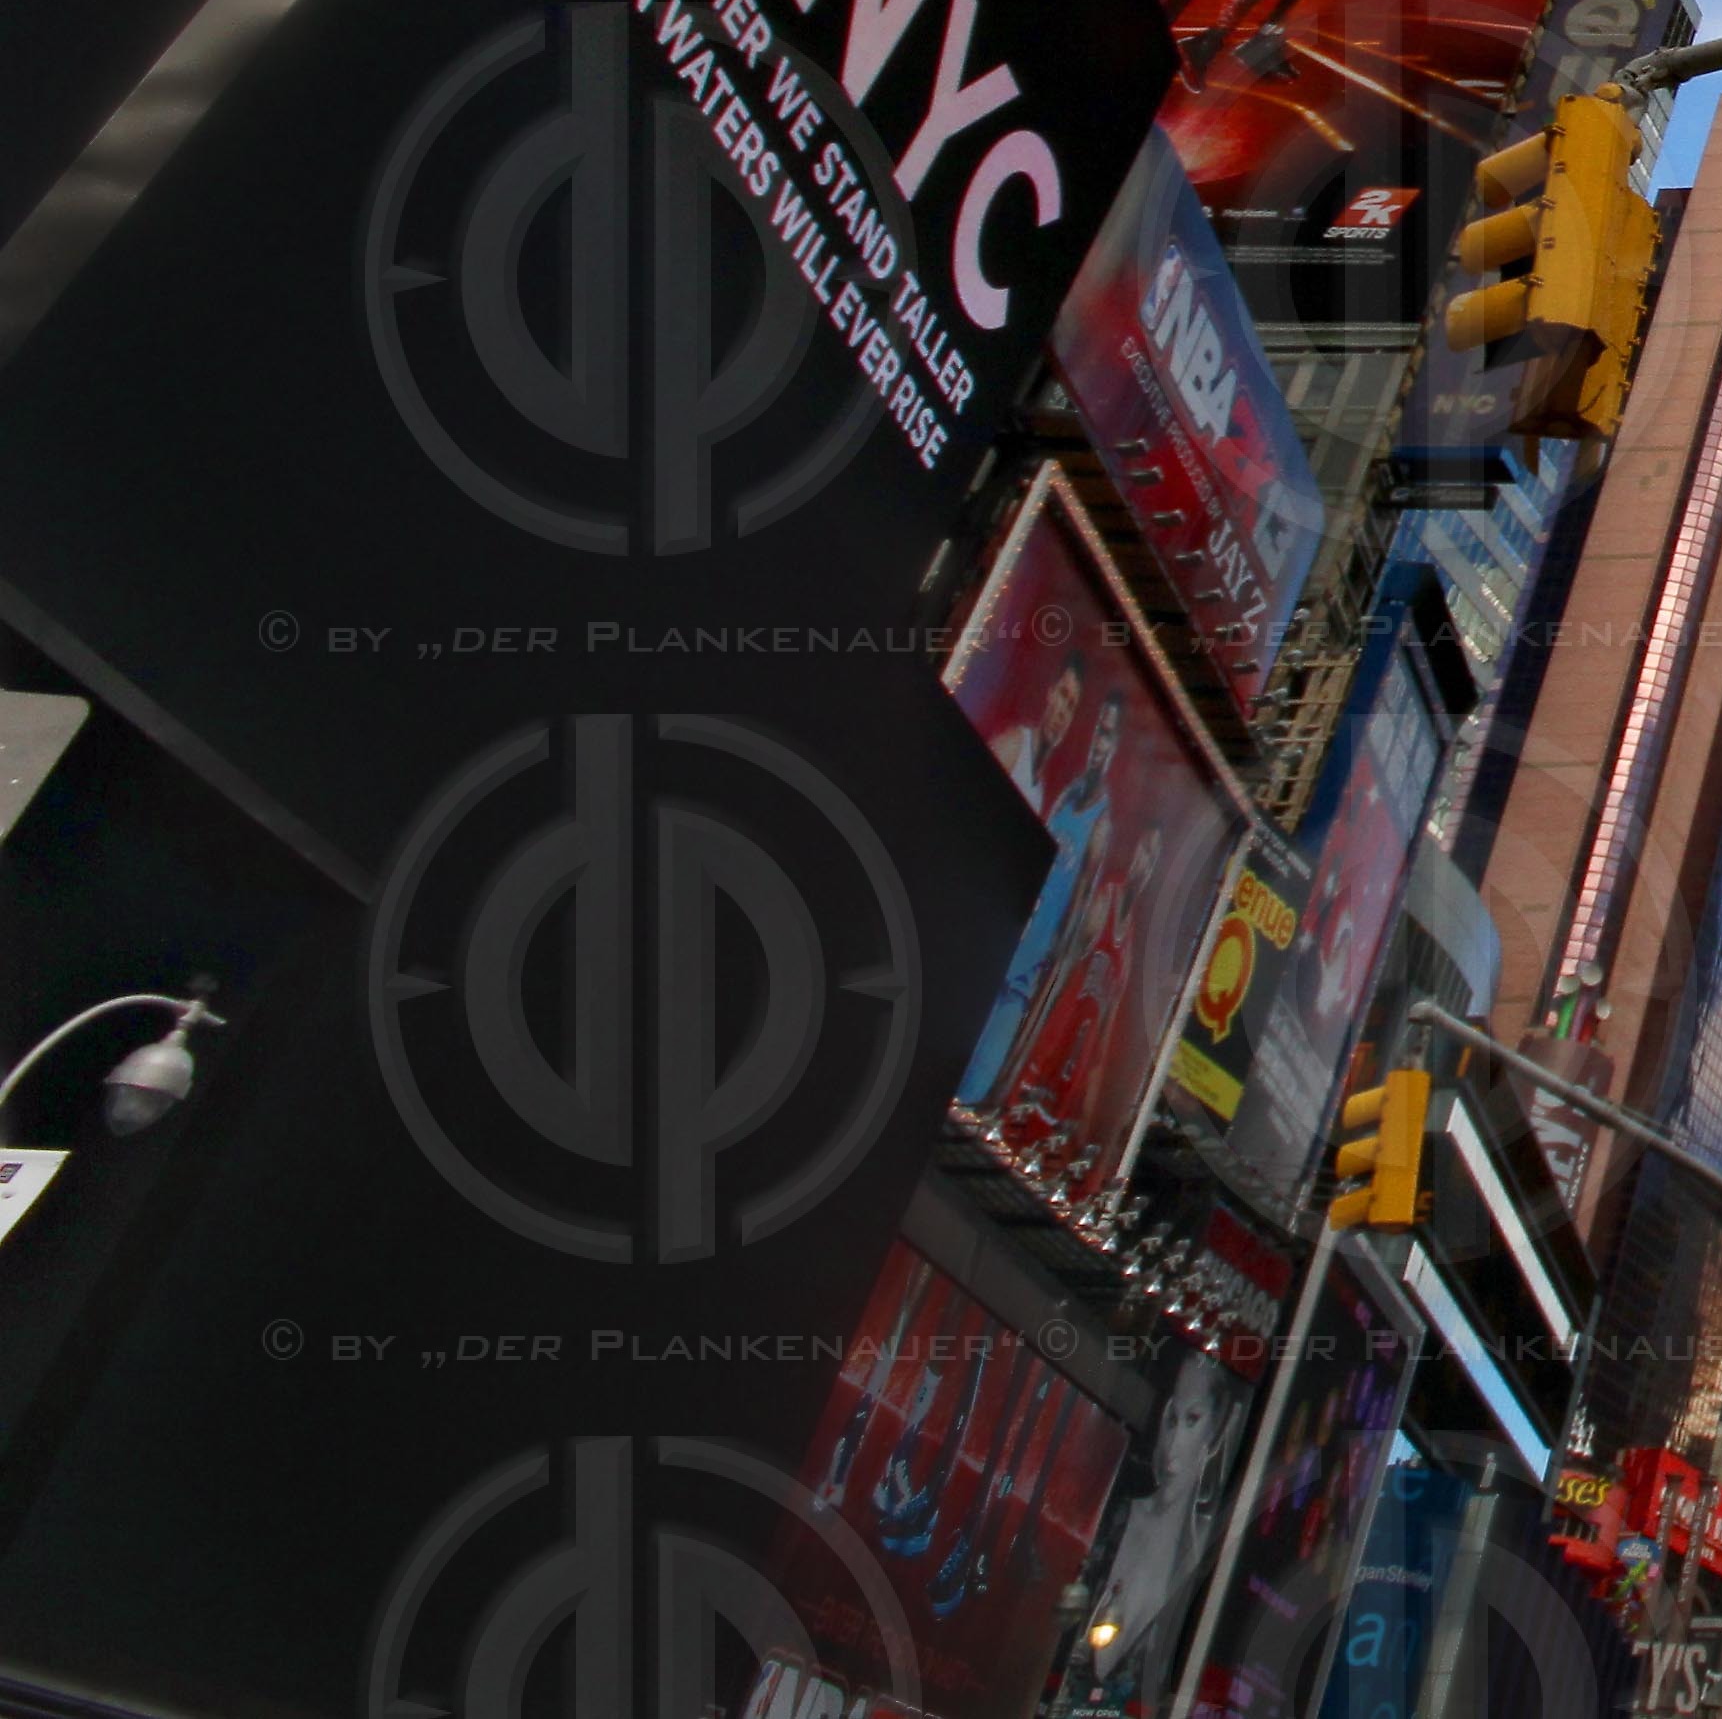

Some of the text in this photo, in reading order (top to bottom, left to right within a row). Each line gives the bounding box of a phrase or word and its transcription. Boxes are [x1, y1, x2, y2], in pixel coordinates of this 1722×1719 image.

[655, 2, 779, 198] WATERS
[770, 180, 844, 307] WILL
[828, 294, 900, 395] EVER
[888, 382, 947, 470] RISE
[766, 57, 823, 141] WE
[812, 143, 898, 280] STAND
[894, 269, 975, 415] TALLER
[1197, 910, 1256, 1044] Q
[1236, 869, 1296, 950] enue
